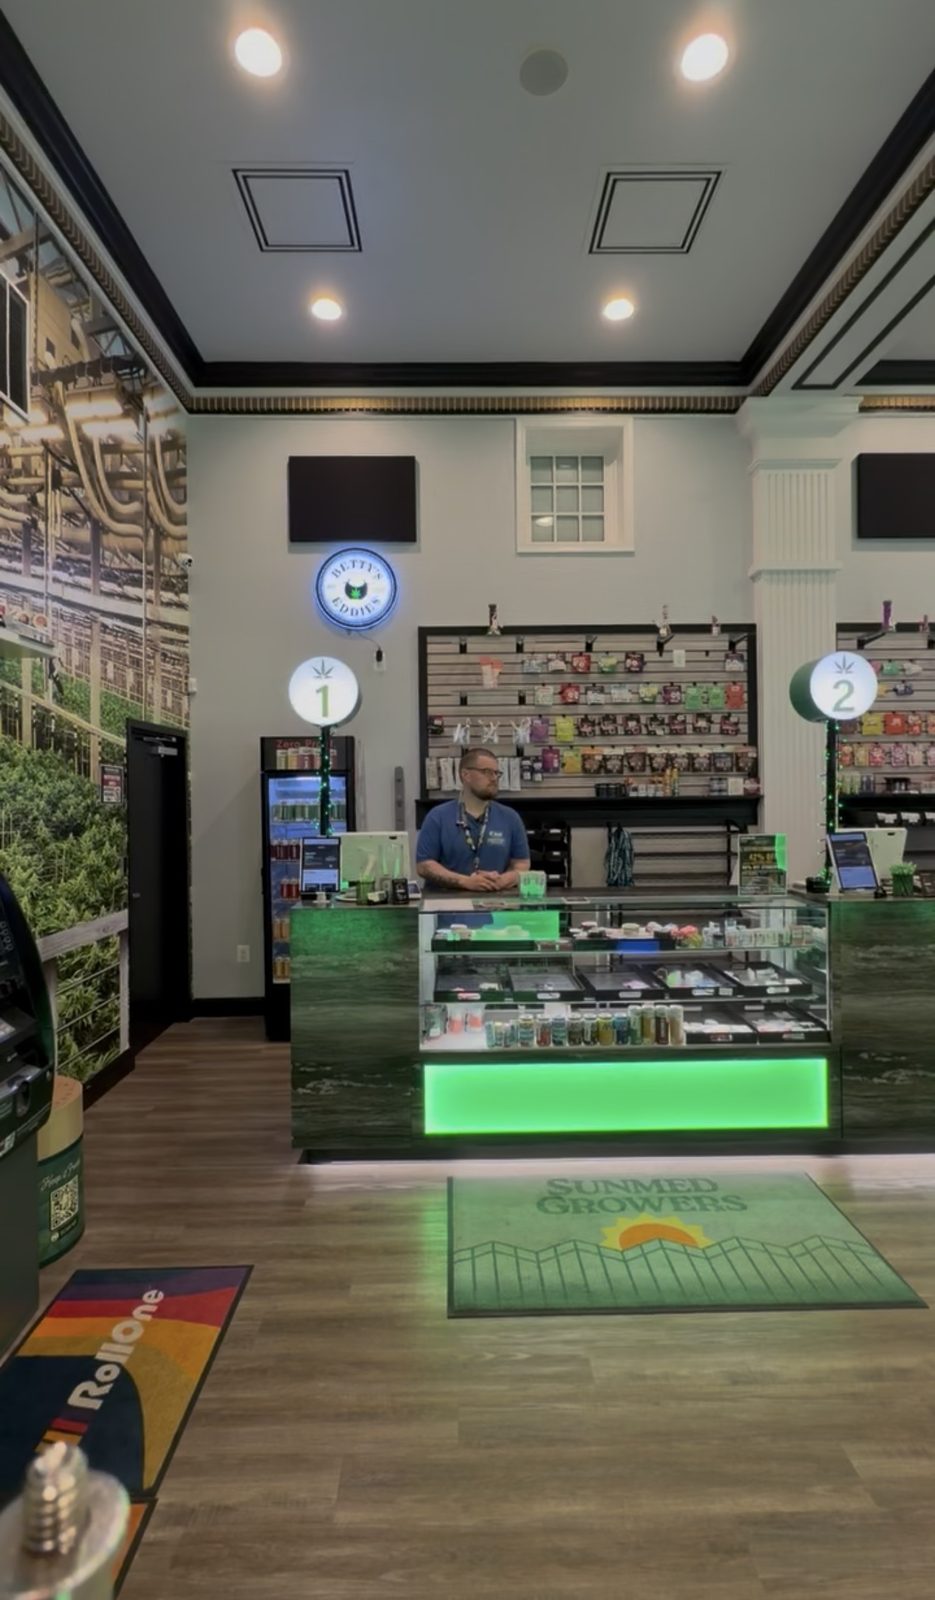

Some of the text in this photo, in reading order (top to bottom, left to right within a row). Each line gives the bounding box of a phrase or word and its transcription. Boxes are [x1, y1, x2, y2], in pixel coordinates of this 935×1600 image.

[331, 596, 382, 617] EDDIES
[316, 684, 330, 718] 1
[832, 679, 855, 712] 2
[546, 1178, 719, 1195] SUNMED
[536, 1194, 748, 1215] GROWERS
